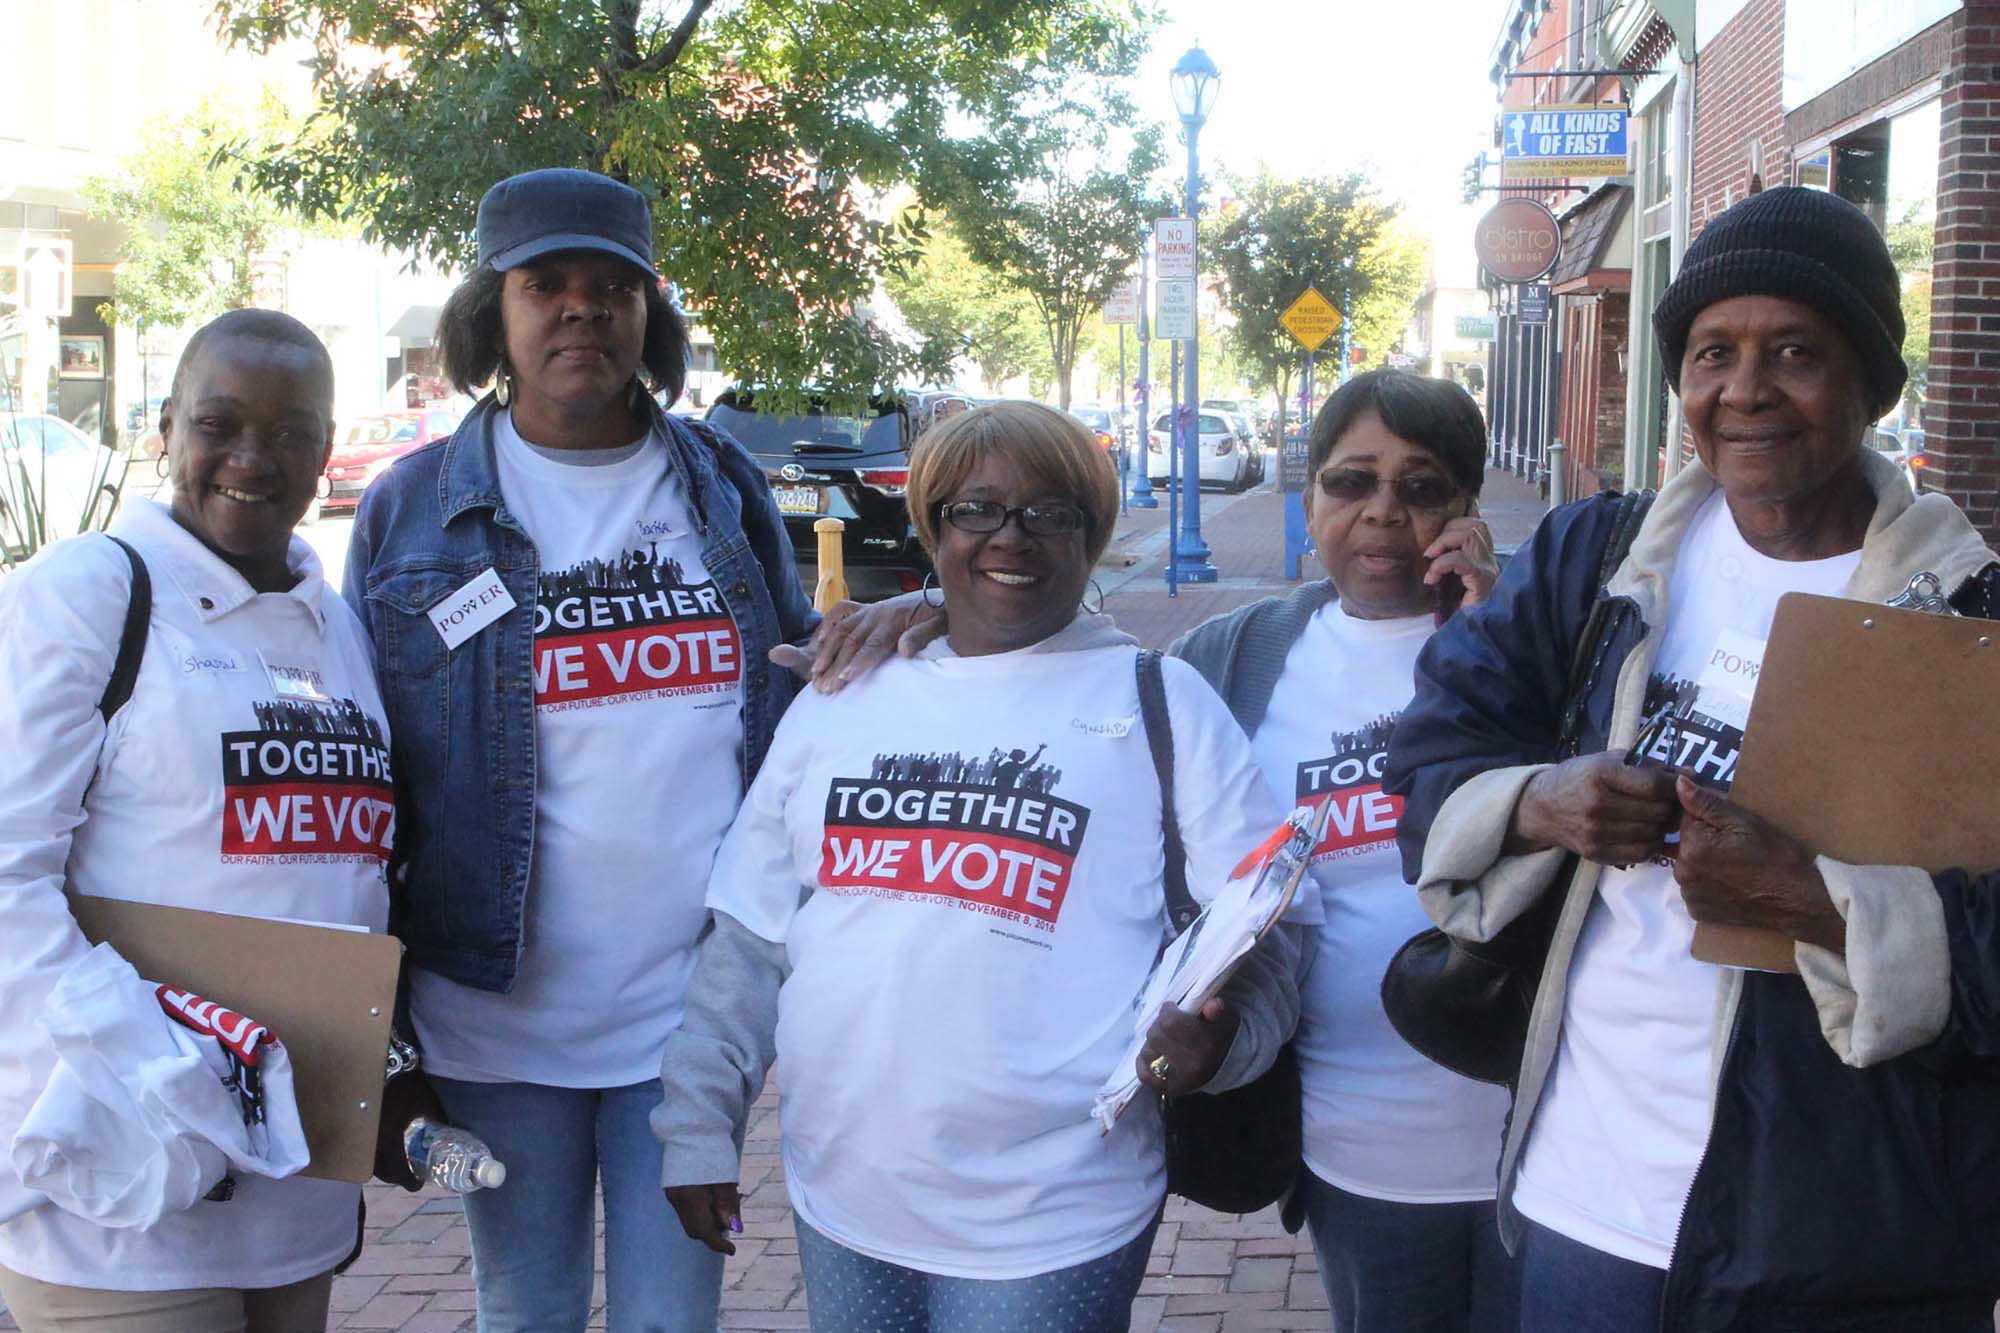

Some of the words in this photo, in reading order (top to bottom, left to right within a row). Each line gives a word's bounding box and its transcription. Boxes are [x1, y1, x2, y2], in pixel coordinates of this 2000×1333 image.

[1530, 113, 1561, 134] ALL
[1564, 112, 1621, 134] KINDS
[1539, 134, 1562, 155] OF
[1564, 134, 1610, 155] FAST
[1158, 243, 1192, 255] PARKING
[1167, 230, 1183, 241] NO
[1528, 287, 1539, 298] M
[439, 584, 504, 634] POWER
[597, 629, 736, 684] VOTE
[546, 702, 567, 713] OUR
[607, 694, 628, 705] OUR
[657, 684, 714, 699] NOVEMBER
[230, 739, 393, 783] TOGETHE
[234, 794, 318, 843] WE
[836, 786, 1077, 847] TOGETHER
[220, 855, 243, 865] OUR
[278, 854, 299, 865] OUR
[1352, 843, 1375, 856] OUR
[829, 837, 911, 879] WE
[920, 839, 1063, 910] VOTE
[851, 887, 869, 897] OUR
[908, 893, 928, 904] OUR
[958, 900, 1021, 922] NOVEMBER
[1023, 915, 1032, 928] 8,
[1035, 921, 1055, 934] 2016
